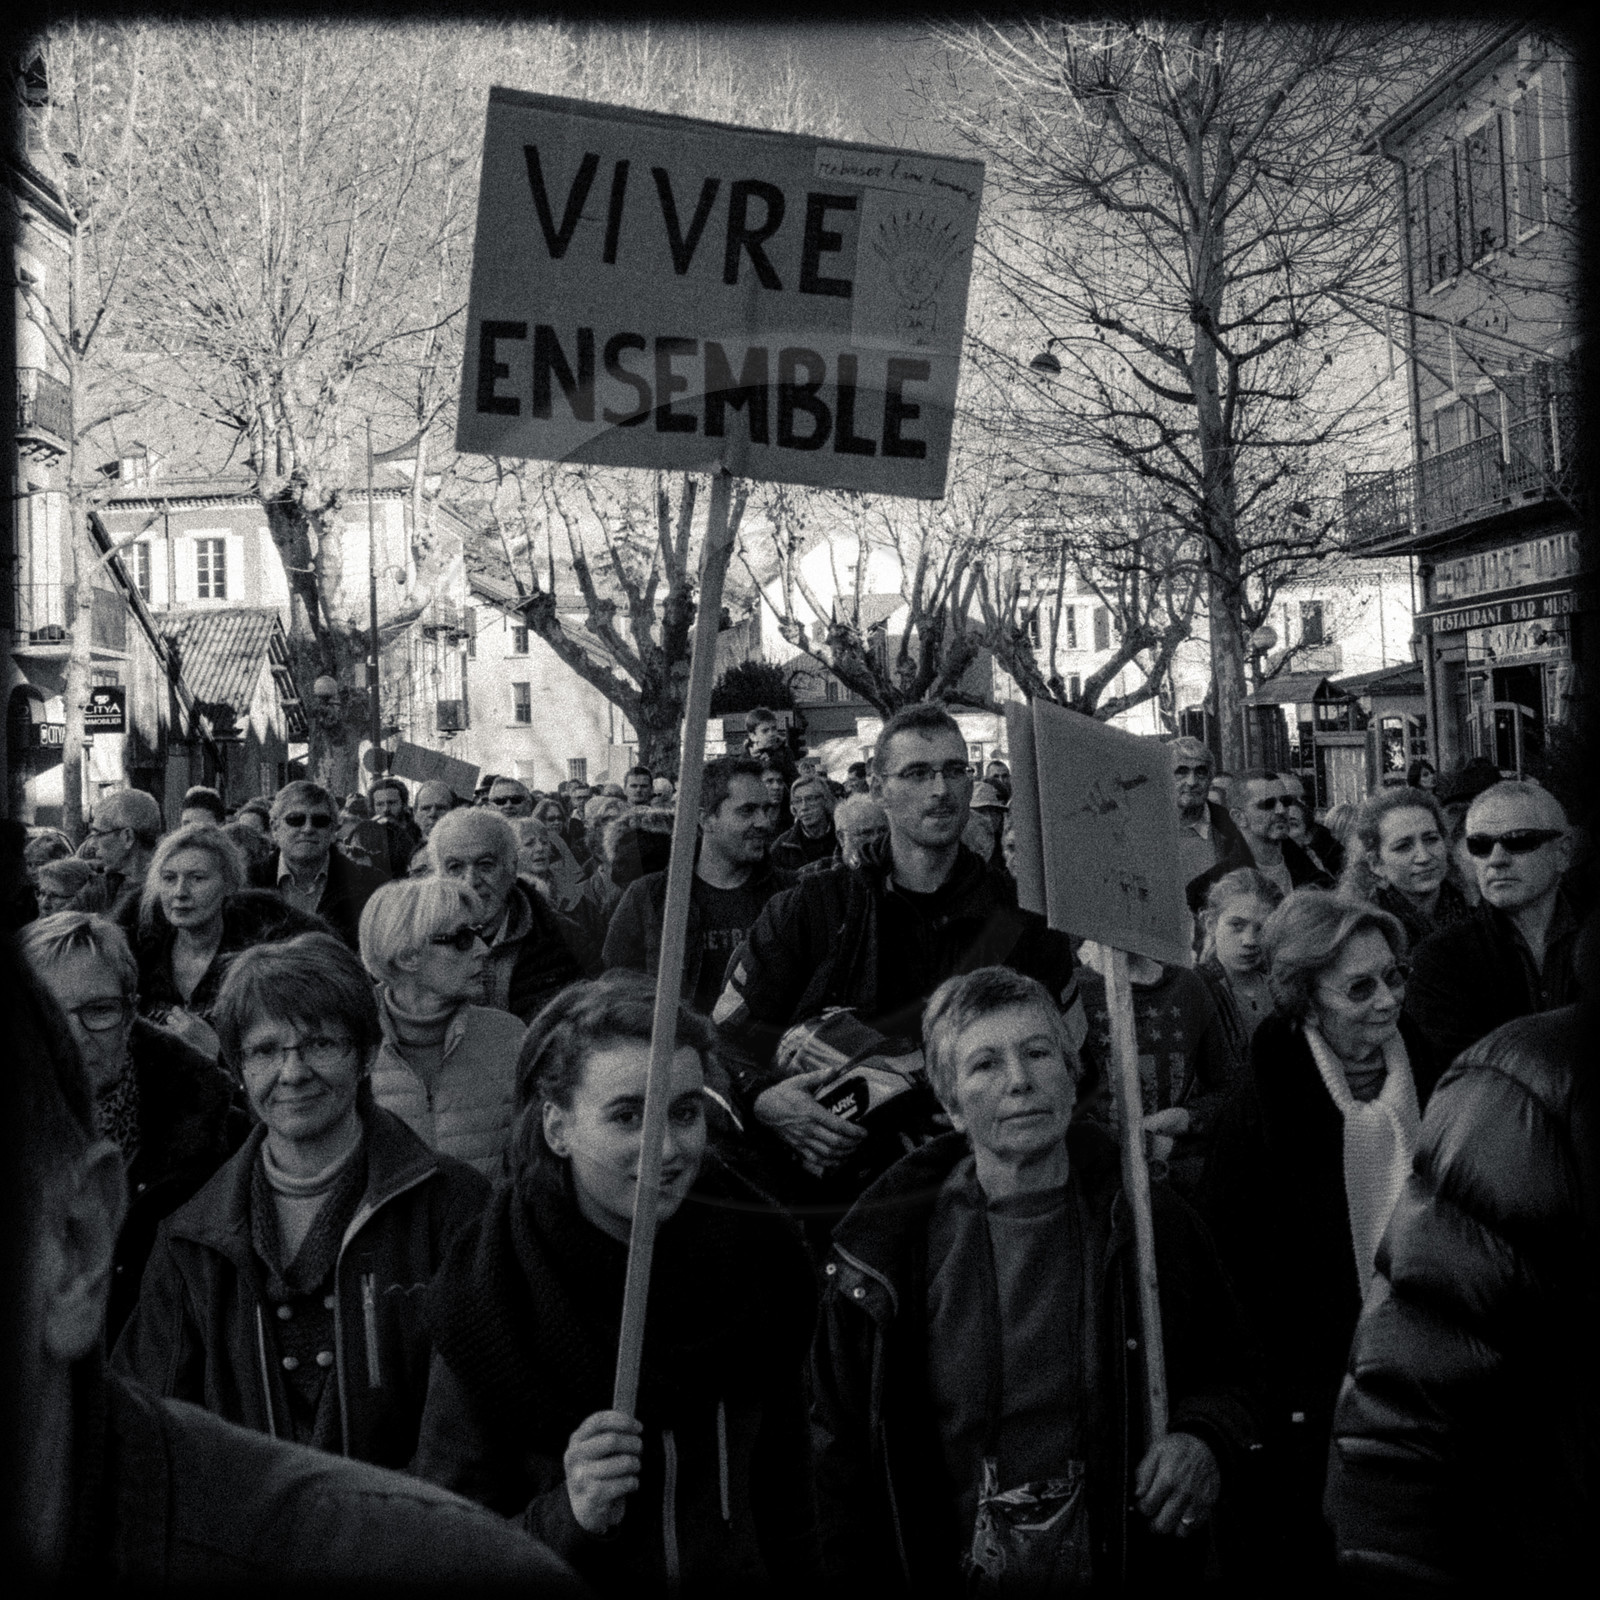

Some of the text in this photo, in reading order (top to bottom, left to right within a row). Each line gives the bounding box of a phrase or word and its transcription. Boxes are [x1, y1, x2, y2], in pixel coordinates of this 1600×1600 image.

[523, 144, 857, 299] VIVRE
[476, 320, 931, 459] ENSEMBLE
[1432, 606, 1503, 632] RESTAURANT
[1511, 601, 1536, 620] BAR
